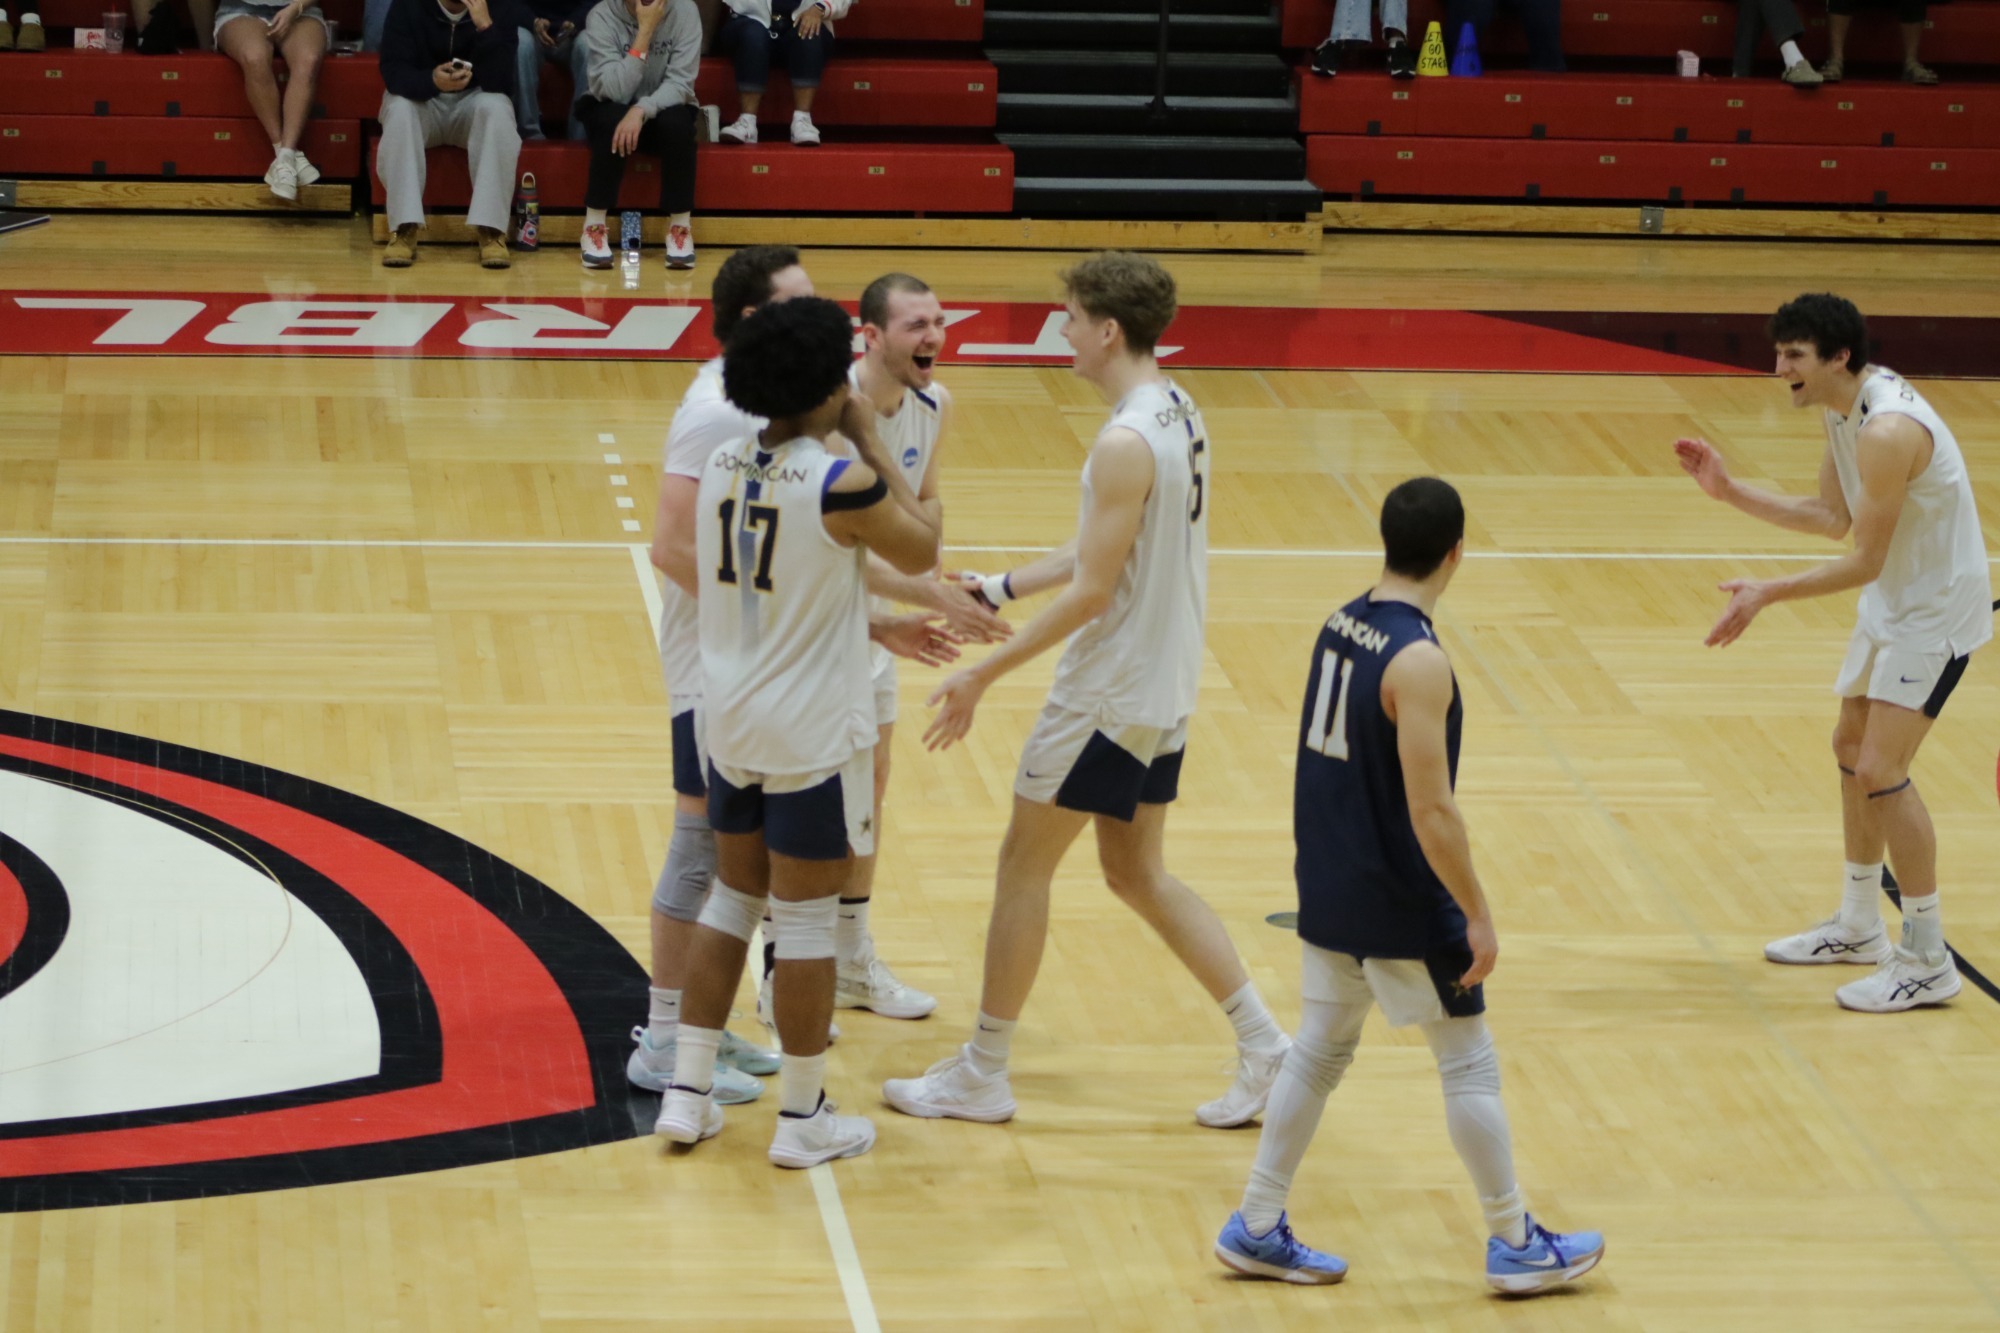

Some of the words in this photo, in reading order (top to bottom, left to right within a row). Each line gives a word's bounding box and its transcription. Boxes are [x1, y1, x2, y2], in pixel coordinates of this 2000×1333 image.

[1428, 43, 1441, 55] GO
[717, 498, 780, 593] 17
[1306, 648, 1354, 761] 11
